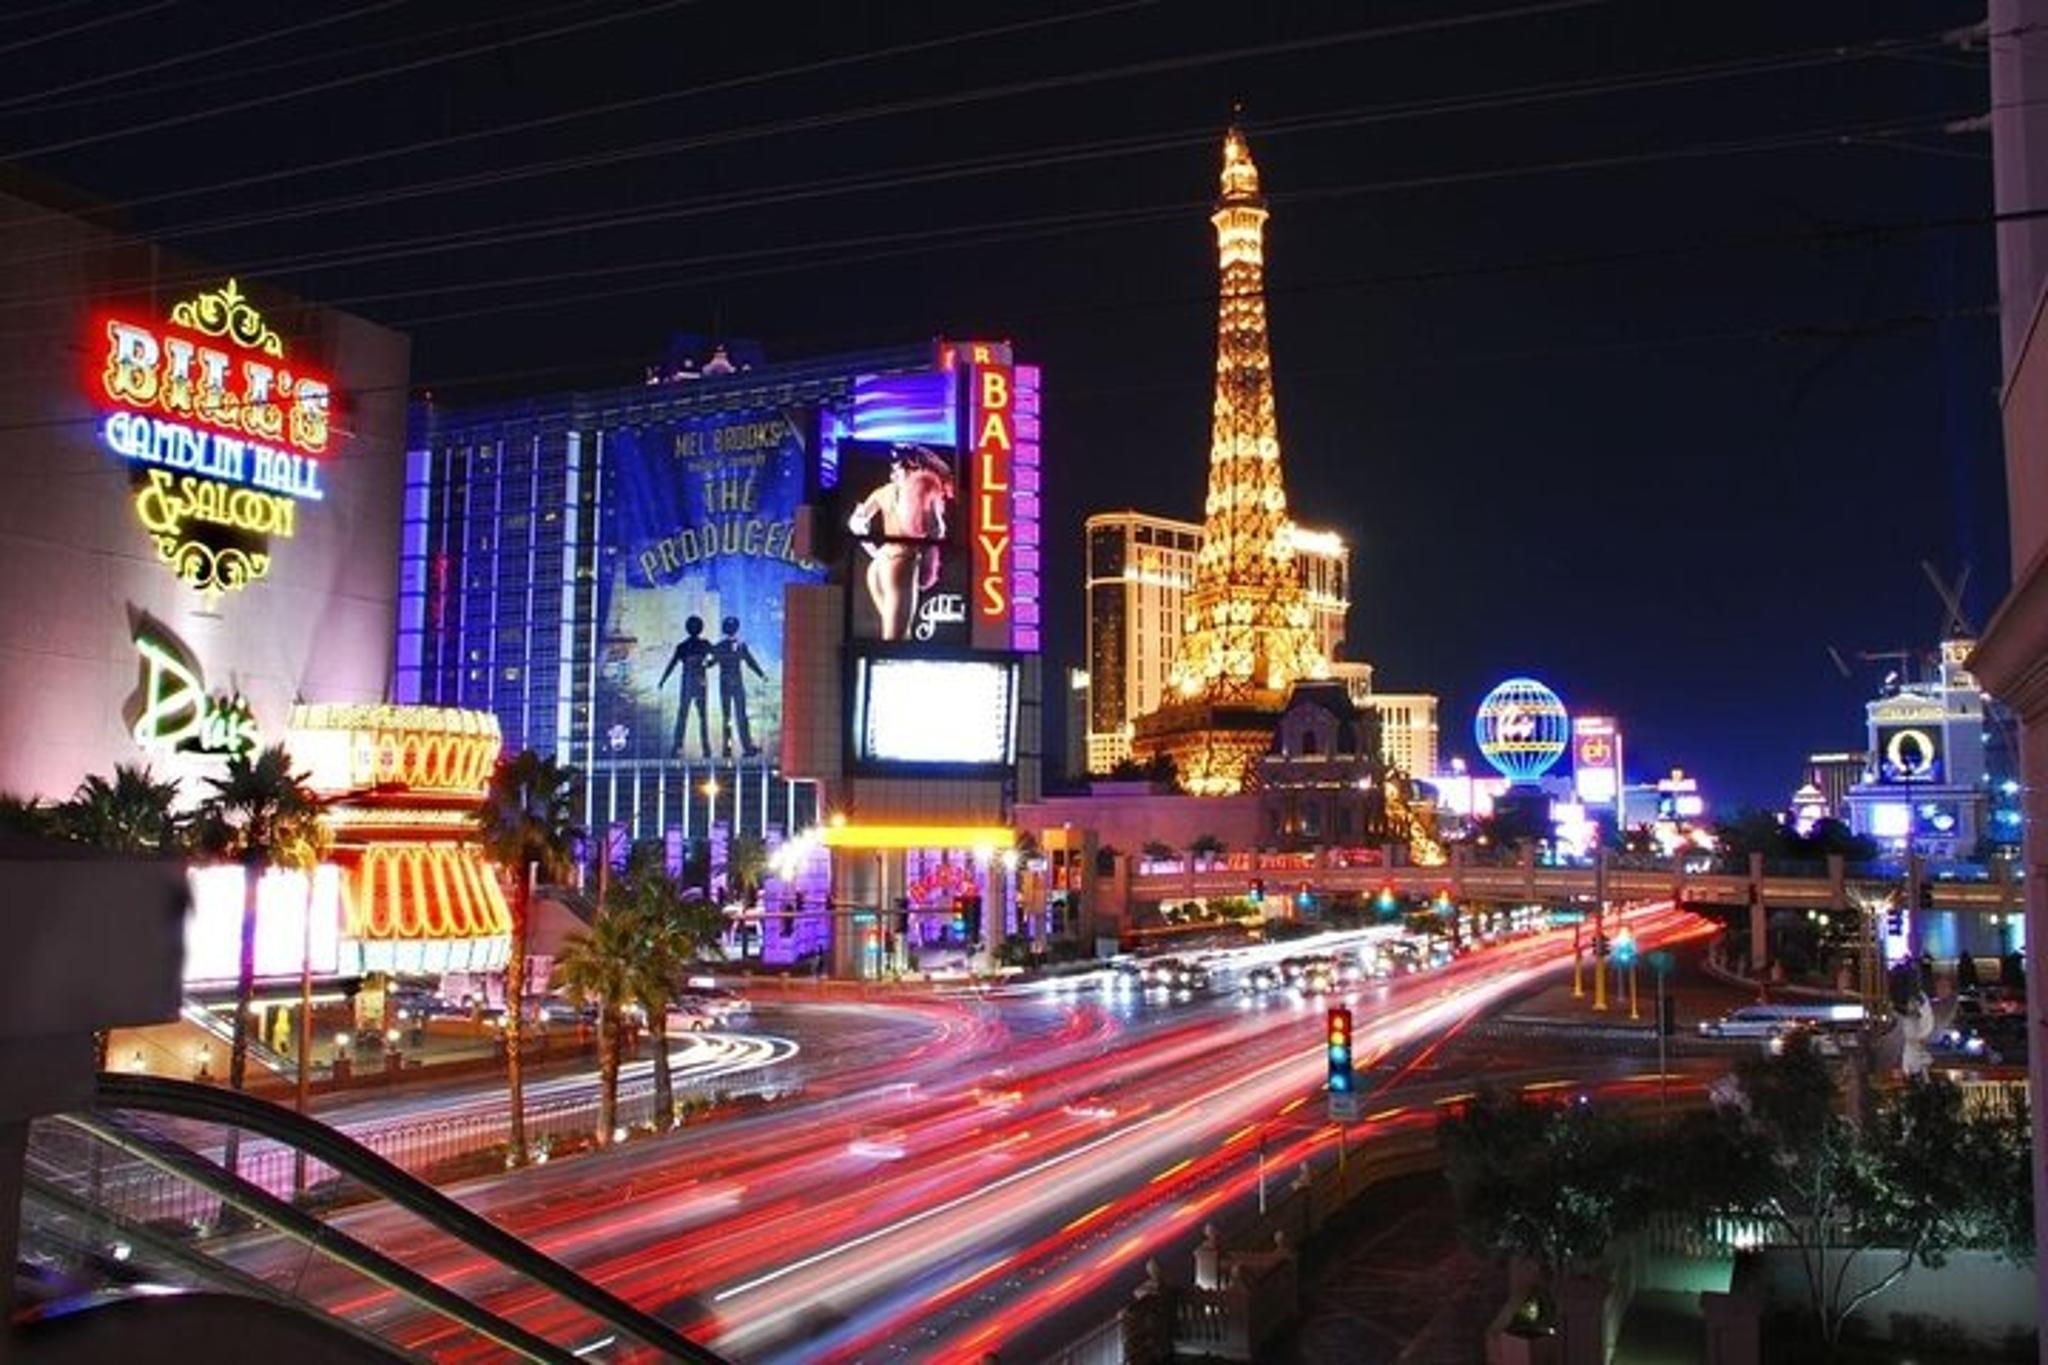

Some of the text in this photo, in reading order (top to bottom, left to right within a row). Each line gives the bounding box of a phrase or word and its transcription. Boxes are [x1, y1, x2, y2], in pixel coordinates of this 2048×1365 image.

[103, 320, 329, 451] BILL'S
[137, 469, 296, 537] & SALOON
[252, 446, 324, 500] HALL
[704, 466, 758, 514] THE
[640, 518, 814, 589] PRODUCER
